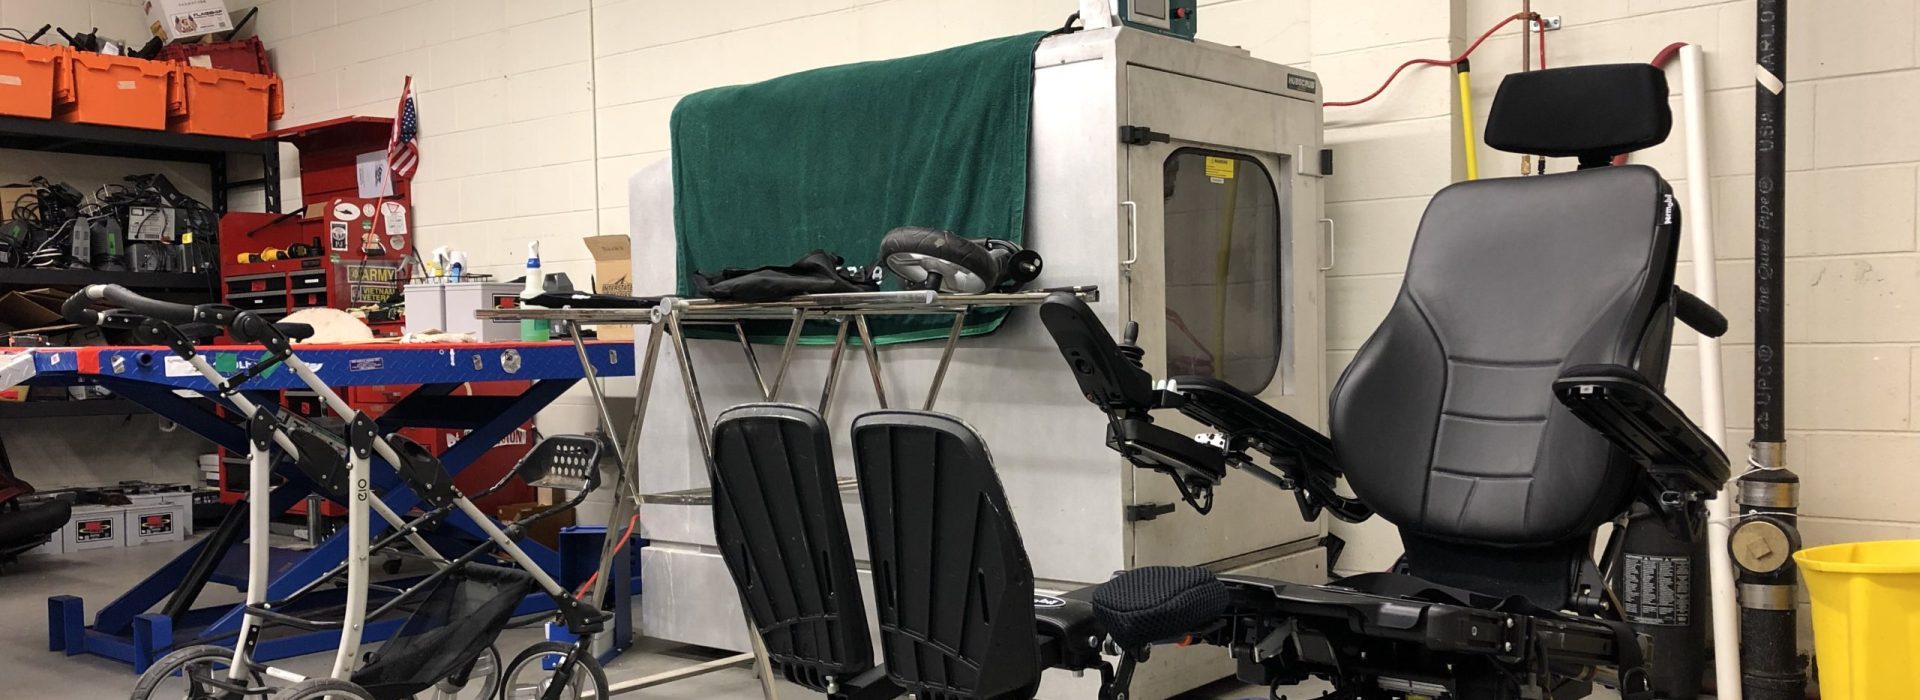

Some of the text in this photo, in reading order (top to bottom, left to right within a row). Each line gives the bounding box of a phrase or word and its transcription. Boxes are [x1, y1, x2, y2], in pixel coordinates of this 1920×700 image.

[1664, 194, 1673, 224] permobil
[1757, 239, 1773, 280] Quiet
[362, 268, 394, 281] ARMY
[1757, 286, 1770, 313] The
